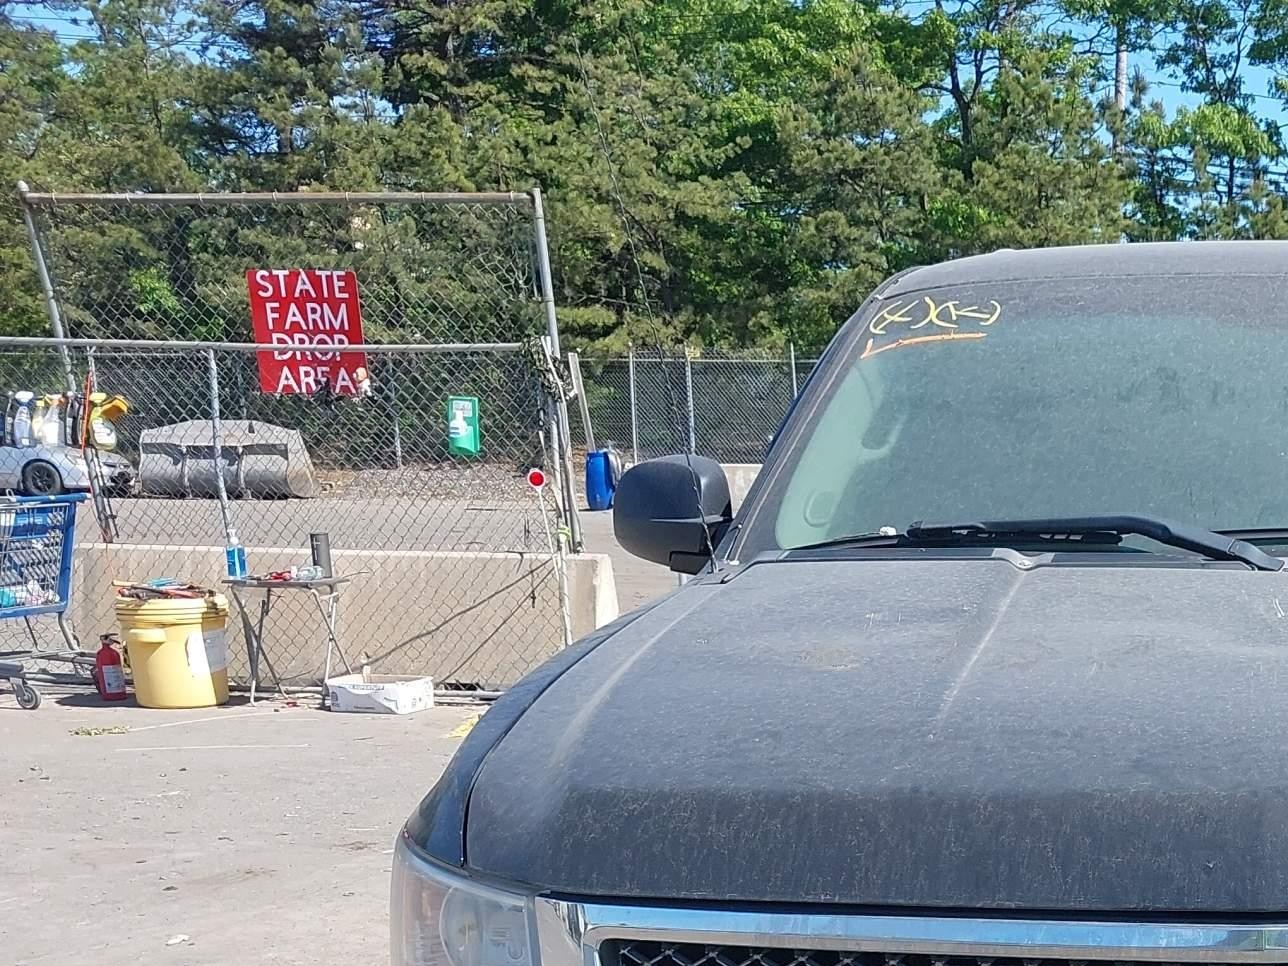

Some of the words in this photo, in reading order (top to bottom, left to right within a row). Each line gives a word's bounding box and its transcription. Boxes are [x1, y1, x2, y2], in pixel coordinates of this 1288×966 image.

[255, 269, 349, 298] STATE
[265, 302, 349, 330] FARM
[272, 333, 349, 361] DROP
[277, 366, 356, 393] AREA
